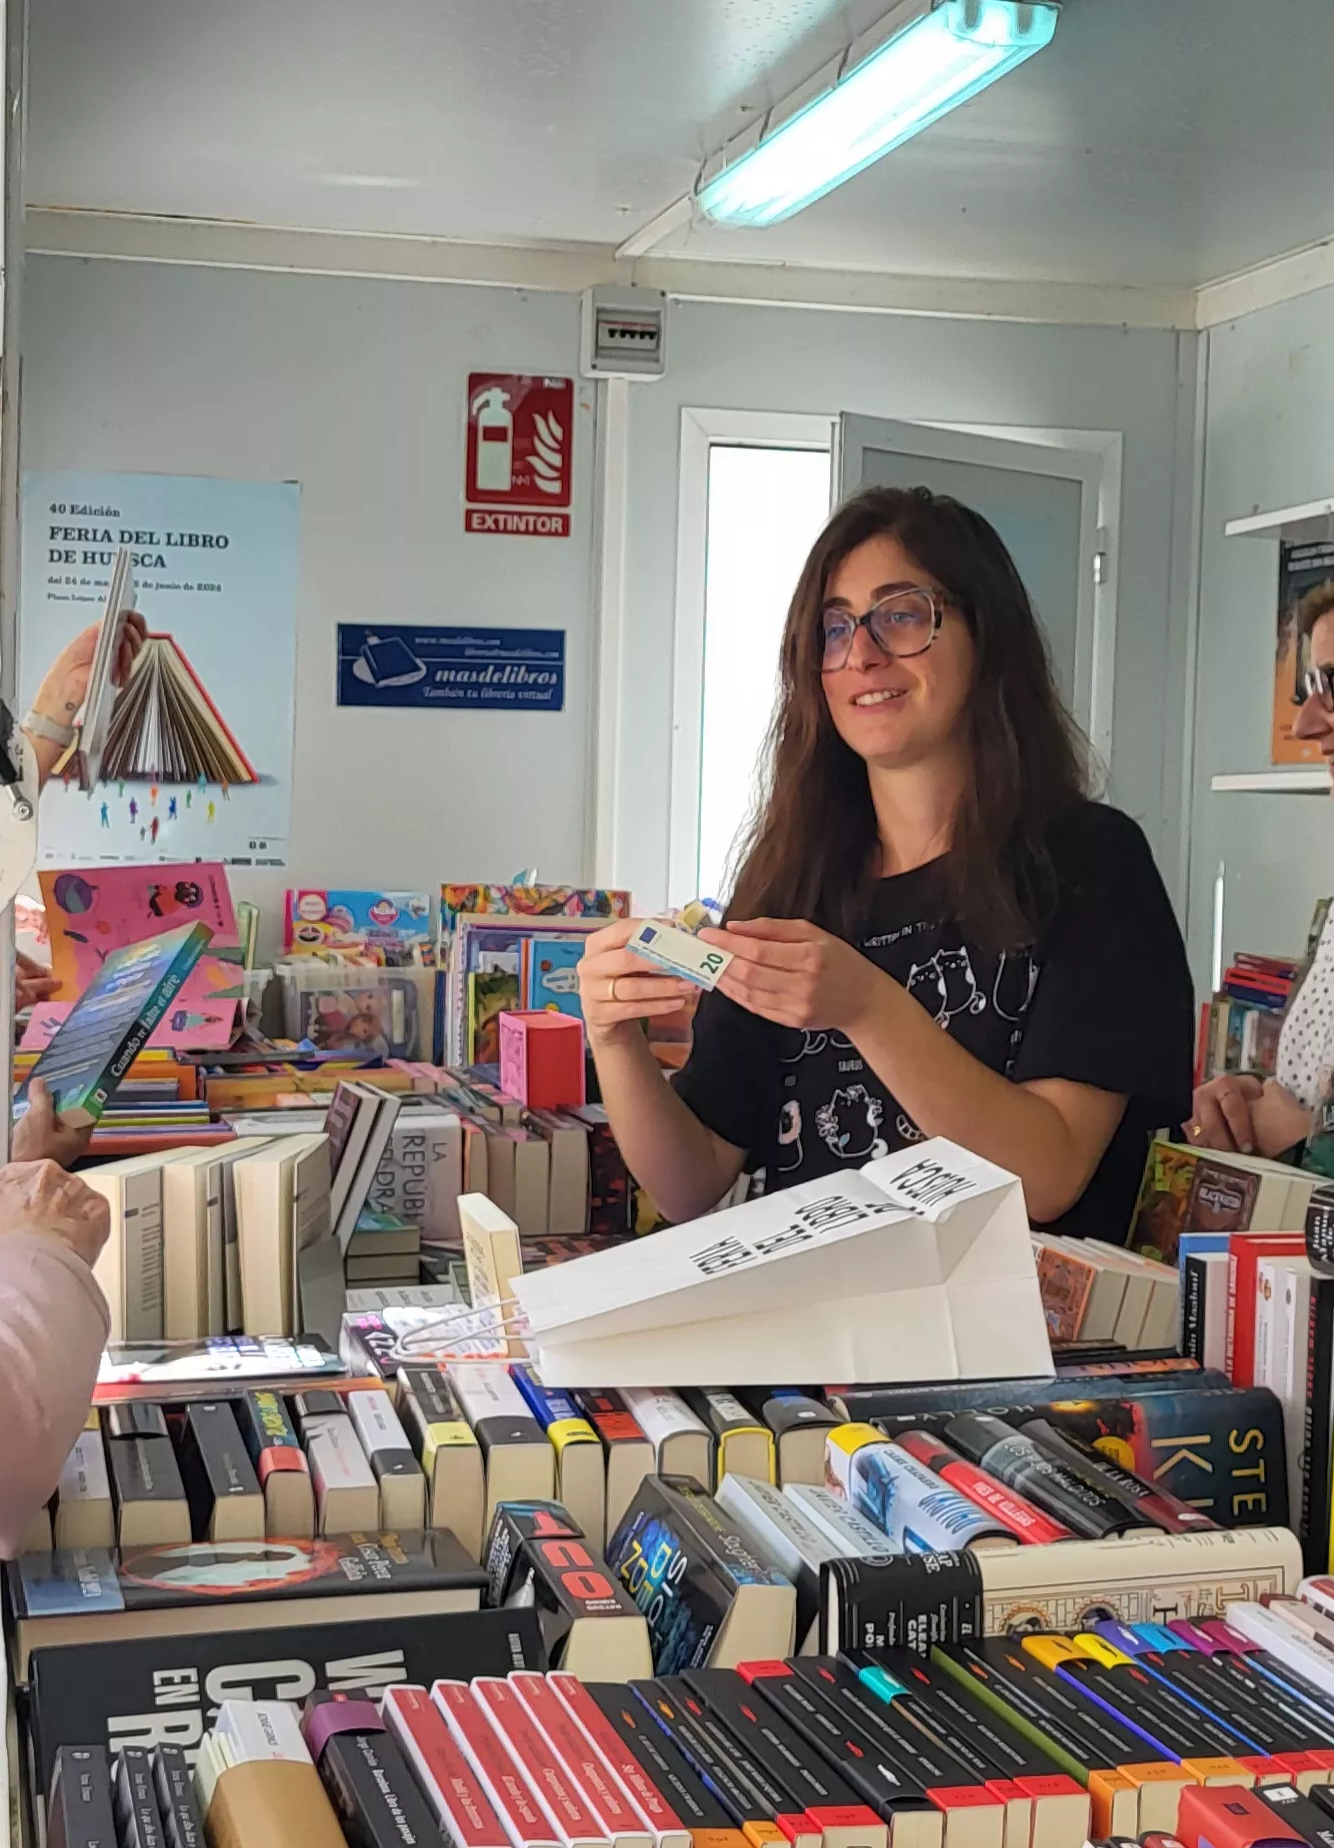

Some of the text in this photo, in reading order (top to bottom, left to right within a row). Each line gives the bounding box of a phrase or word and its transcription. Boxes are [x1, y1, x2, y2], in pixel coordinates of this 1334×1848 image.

[49, 503, 121, 517] 40 Edición
[471, 514, 564, 534] EXTINTOR
[49, 526, 229, 549] FERIA DEL LIBRO
[48, 549, 168, 568] DE HUSCA
[435, 664, 558, 685] masdelibros
[699, 952, 725, 975] 20
[111, 1040, 141, 1077] Cuando
[432, 1141, 448, 1163] LA
[401, 1134, 427, 1221] REPÚB
[888, 1156, 978, 1207] HUESCA
[794, 1194, 870, 1234] LIBRO
[688, 1234, 758, 1276] FERIA
[1150, 1433, 1214, 1509] KI
[152, 1667, 202, 1706] EN
